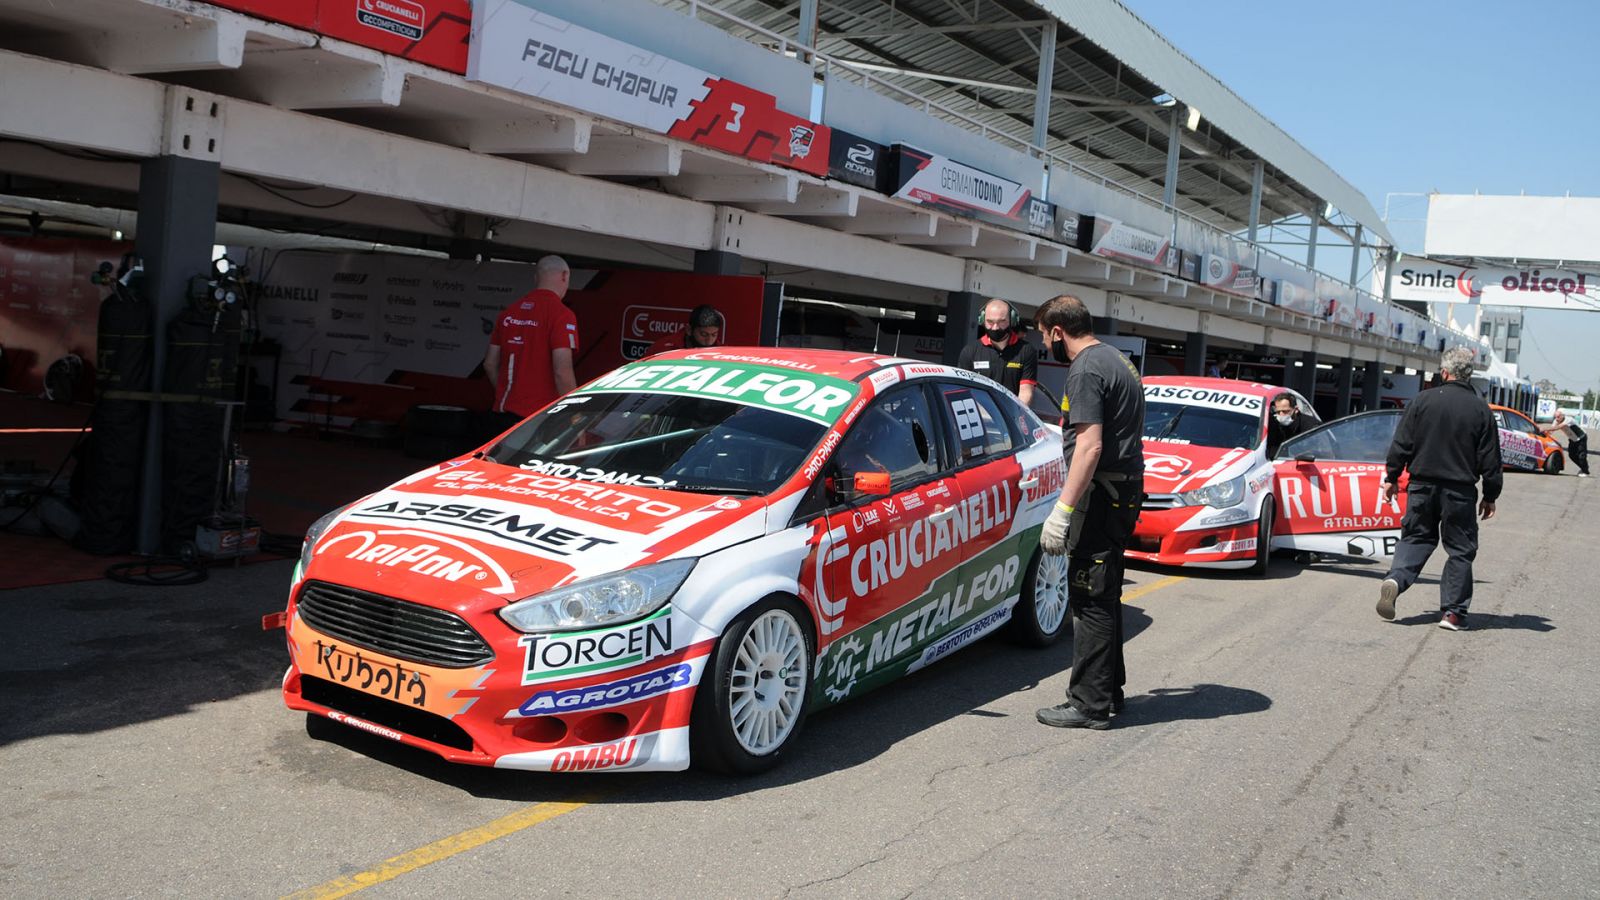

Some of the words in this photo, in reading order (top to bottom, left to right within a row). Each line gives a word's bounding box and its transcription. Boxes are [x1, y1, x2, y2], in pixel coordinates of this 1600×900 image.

[376, 0, 419, 20] CRUCIANELLI
[522, 38, 589, 79] FACU
[592, 61, 678, 108] CHAPUR
[725, 103, 745, 132] 3
[1029, 200, 1048, 228] 56
[1502, 269, 1587, 297] olicol
[712, 354, 816, 370] CRUCIANELLI
[582, 364, 853, 417] METALFOR
[1321, 465, 1386, 475] PARADOR
[435, 470, 488, 483] EL
[507, 473, 681, 517] TORITO
[1279, 471, 1401, 519] RUTA
[362, 501, 620, 552] ARSEMET
[850, 479, 1012, 598] CRUCIANELLI
[1324, 516, 1394, 528] ATALAYA
[865, 554, 1020, 673] METALFOR
[522, 618, 672, 671] TORCEN
[317, 640, 426, 707] Kubota
[525, 669, 685, 711] AGROTAX
[550, 738, 638, 772] OMBU
